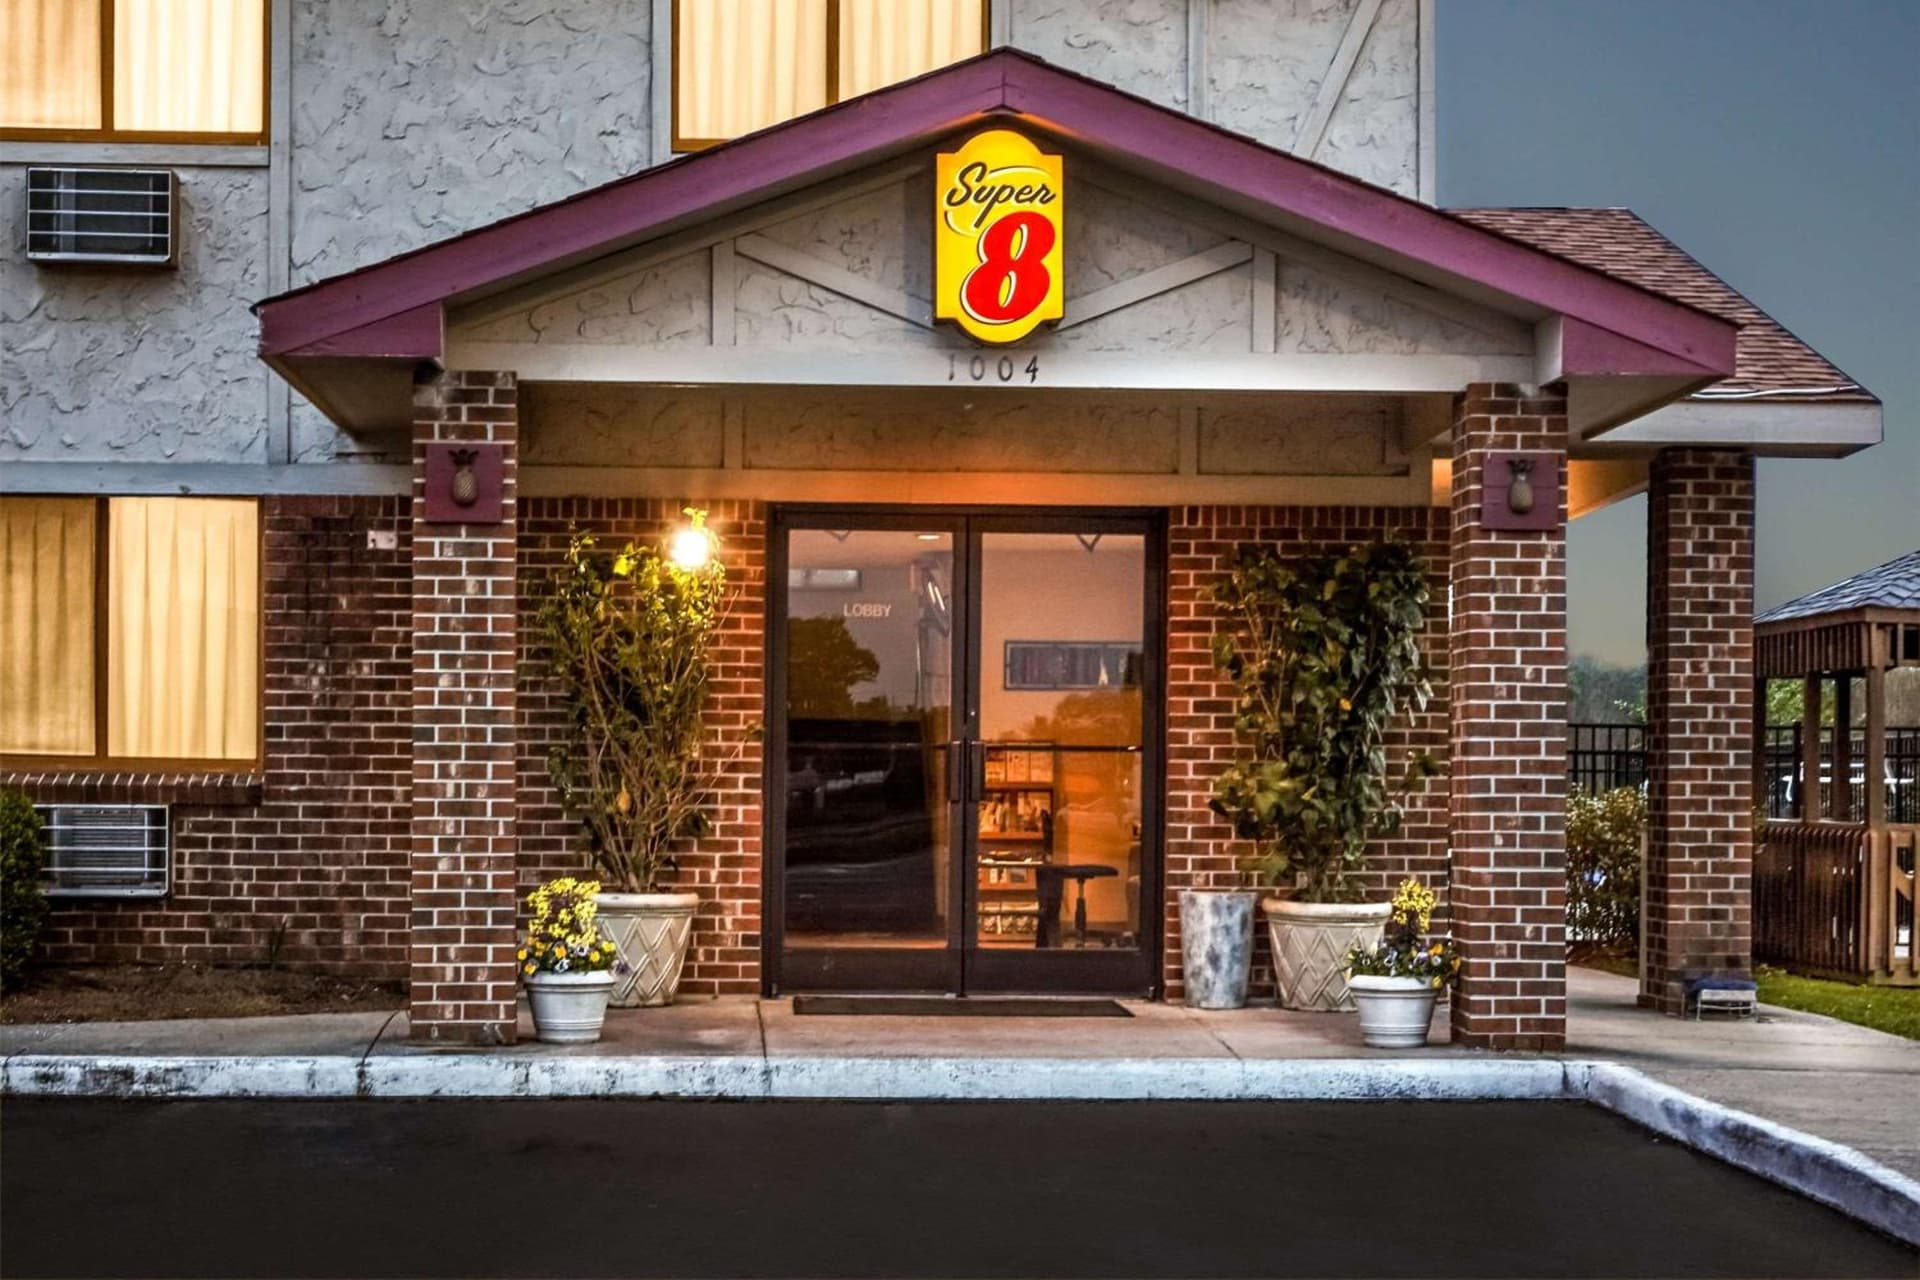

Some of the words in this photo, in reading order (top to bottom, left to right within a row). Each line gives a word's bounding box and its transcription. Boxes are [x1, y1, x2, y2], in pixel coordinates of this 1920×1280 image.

[946, 162, 1056, 228] Super
[960, 211, 1056, 324] 8
[948, 354, 1039, 383] 1004
[843, 603, 892, 617] LOBBY
